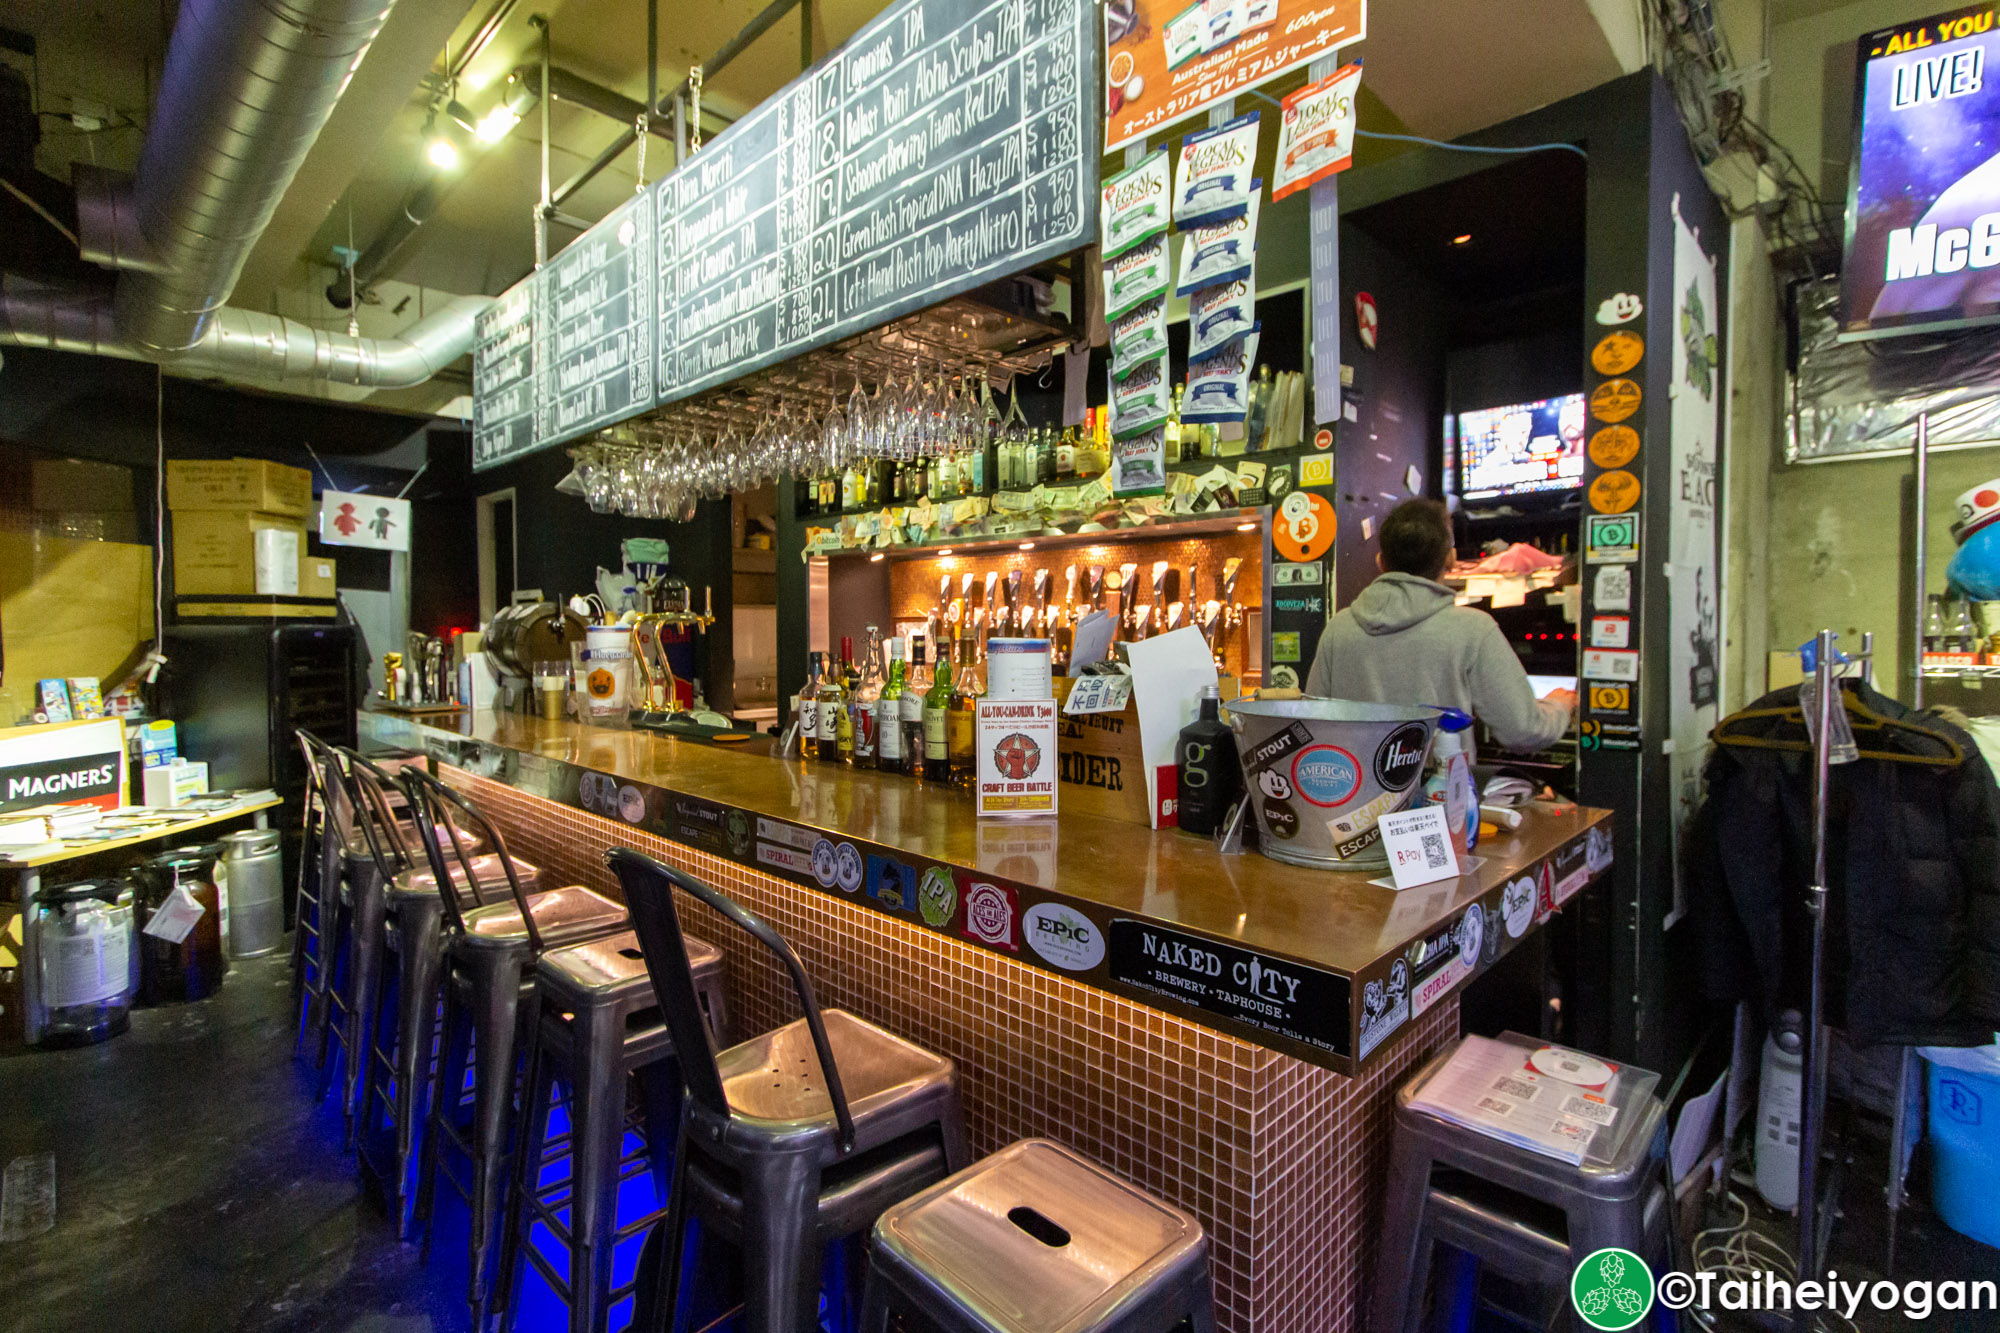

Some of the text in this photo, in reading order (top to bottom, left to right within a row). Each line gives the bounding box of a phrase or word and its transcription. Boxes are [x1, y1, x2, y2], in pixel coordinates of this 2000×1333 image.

[1884, 10, 1993, 57] ALL YOU
[818, 5, 925, 115] 17. Lagunitas IPA
[1172, 31, 1269, 87] Australian Made
[1891, 46, 1985, 111] LIVE!
[816, 121, 840, 169] 18.
[847, 102, 878, 150] Ballast
[883, 81, 909, 126] Point
[914, 50, 949, 107] Aloha
[950, 23, 994, 84] Sculpin
[1286, 96, 1350, 148] LEGENDS
[1186, 144, 1247, 182] LEGENDS
[1197, 138, 1235, 160] LOCAL
[815, 178, 837, 223] 19.
[927, 108, 961, 151] Titans
[1048, 168, 1074, 198] 950
[1111, 175, 1162, 216] LEGENDS
[1116, 171, 1151, 198] LOCAL
[813, 231, 836, 275] 20.
[842, 223, 869, 259] Green
[970, 153, 1001, 198] Hazy
[1043, 211, 1075, 240] 1250
[661, 228, 677, 266] 13.
[661, 275, 677, 314] 14.
[680, 253, 699, 298] Little
[740, 221, 757, 263] IPA
[811, 282, 834, 325] 21.
[843, 265, 866, 313] Left
[867, 246, 894, 301] Hand
[896, 241, 922, 290] Push
[924, 235, 943, 283] Pop
[945, 225, 978, 270] Party
[1204, 294, 1235, 313] BEEF JERKY
[661, 318, 677, 349] 15.
[661, 357, 677, 387] 16.
[680, 351, 701, 382] Sierra
[702, 331, 730, 371] Nevada
[730, 322, 745, 360] Pale
[746, 318, 760, 354] Ale
[1122, 382, 1151, 397] BEEF JERKY
[1203, 382, 1225, 392] ORIGINAL
[981, 705, 1034, 719] ALL-YOU-CAN-DRINK
[1088, 713, 1124, 734] FRUIT
[1257, 734, 1292, 762] STOUT
[1385, 740, 1423, 773] Heretic
[8, 765, 114, 800] MAGNERS
[982, 781, 1052, 793] CRAFT BEER BATTLE
[1058, 751, 1123, 792] IDER
[1301, 764, 1354, 781] AMERICAN
[699, 809, 718, 822] STOUT
[1390, 820, 1439, 837] お支払いは楽天ペイで
[681, 826, 698, 839] ESCAPE
[1341, 828, 1380, 857] ESCAP
[766, 850, 794, 867] SPIRAL
[1406, 849, 1421, 862] Pay
[922, 872, 953, 916] IPA
[973, 902, 1006, 925] ACES ALES
[1142, 932, 1302, 1004] NAKED CITY
[1155, 970, 1283, 1020] BREWERY TAPHOUSE
[1422, 970, 1452, 1004] SPIRAL
[1263, 1020, 1280, 1031] Beer
[1282, 1026, 1303, 1041] Tells
[1312, 1037, 1335, 1052] Story
